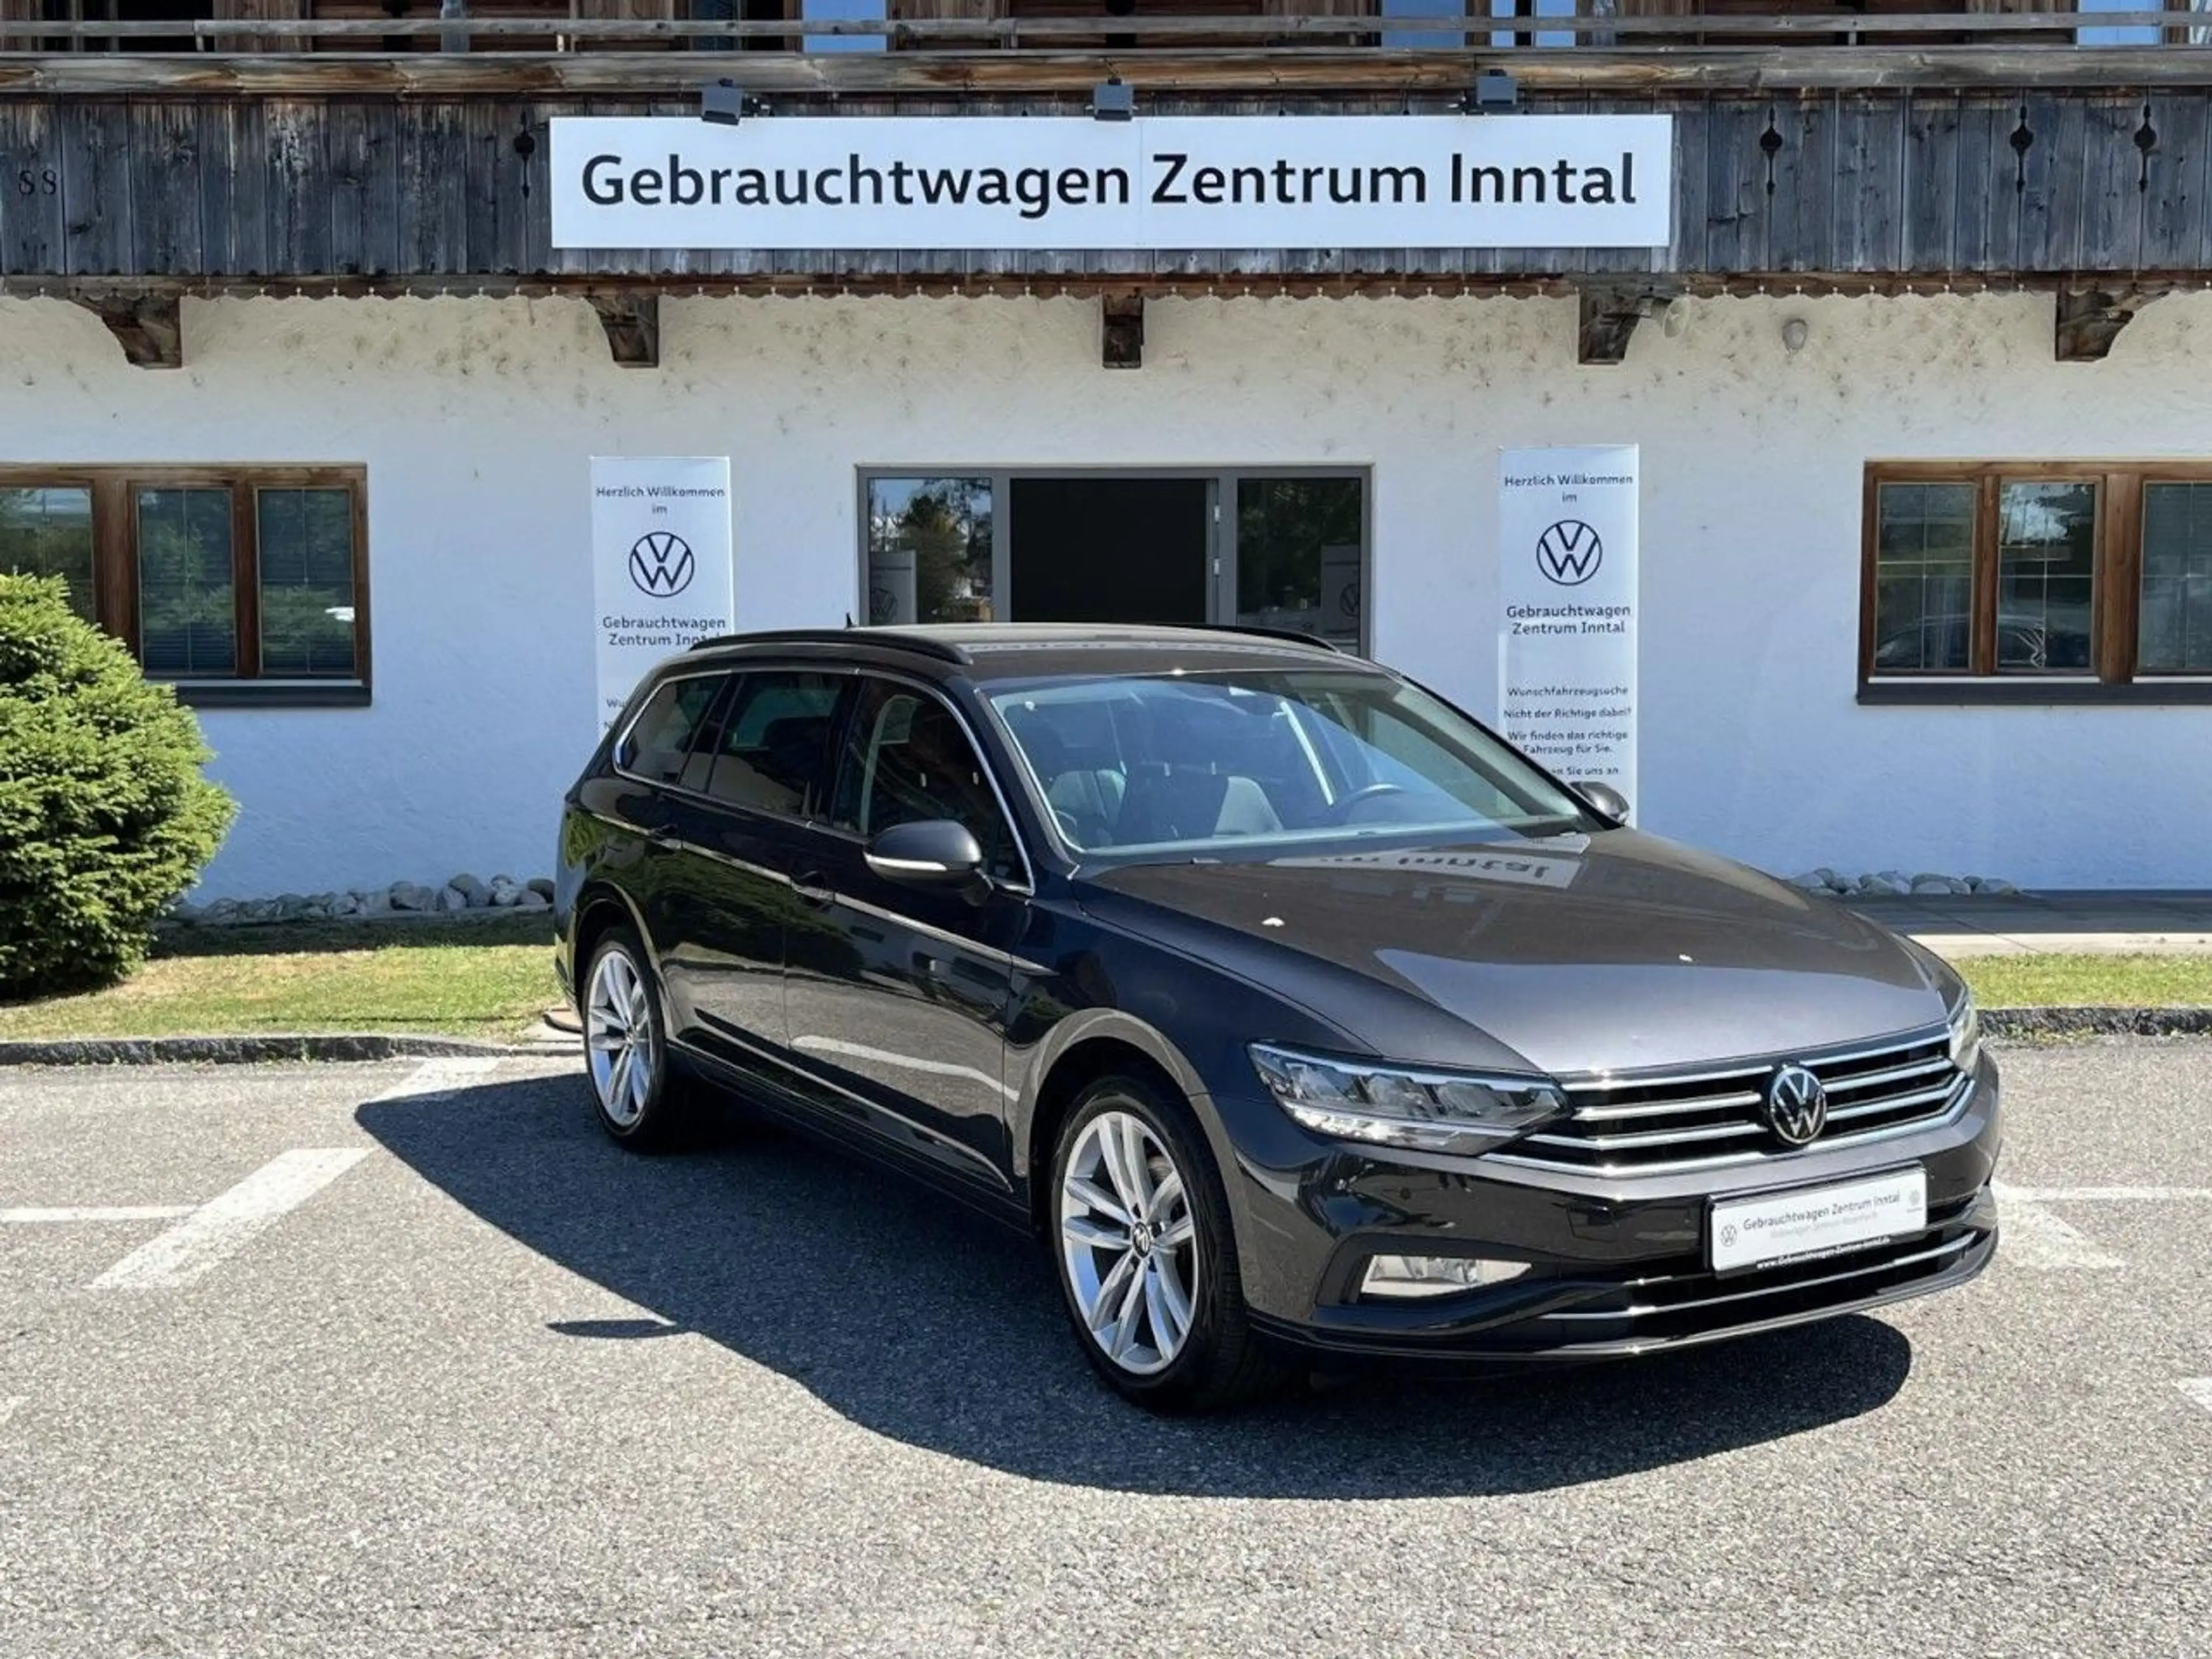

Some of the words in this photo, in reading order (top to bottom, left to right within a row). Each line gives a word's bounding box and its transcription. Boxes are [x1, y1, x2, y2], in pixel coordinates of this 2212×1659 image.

[582, 153, 1128, 219] Gebrauchtwagen
[1152, 154, 1426, 204] Zentrum
[1452, 152, 1636, 204] Inntal
[1504, 473, 1554, 487] Herzlich
[1558, 472, 1633, 486] Willkommen
[596, 486, 644, 498] Herzlich
[647, 486, 725, 498] Willkommen
[1562, 492, 1577, 502] im
[652, 504, 668, 514] im
[1536, 520, 1603, 586] VW
[629, 531, 695, 598] VW
[1506, 604, 1631, 619] Gebrauchtwagen
[603, 615, 725, 631] Gebrauchtwagen
[1512, 622, 1577, 635] Zentrum
[1581, 621, 1626, 634] Inntal
[608, 632, 672, 646] Zentrum
[1503, 709, 1532, 719] Nicht
[1534, 708, 1551, 718] der
[1554, 708, 1597, 719] Richtige
[1530, 731, 1564, 741] finden
[1567, 731, 1586, 740] das
[1588, 730, 1628, 741] richtige
[1522, 744, 1573, 755] Fahrzeug
[1575, 744, 1593, 753] für
[1743, 1207, 1830, 1230] Gebrauchtwagen
[1832, 1198, 1872, 1215] Zentrum
